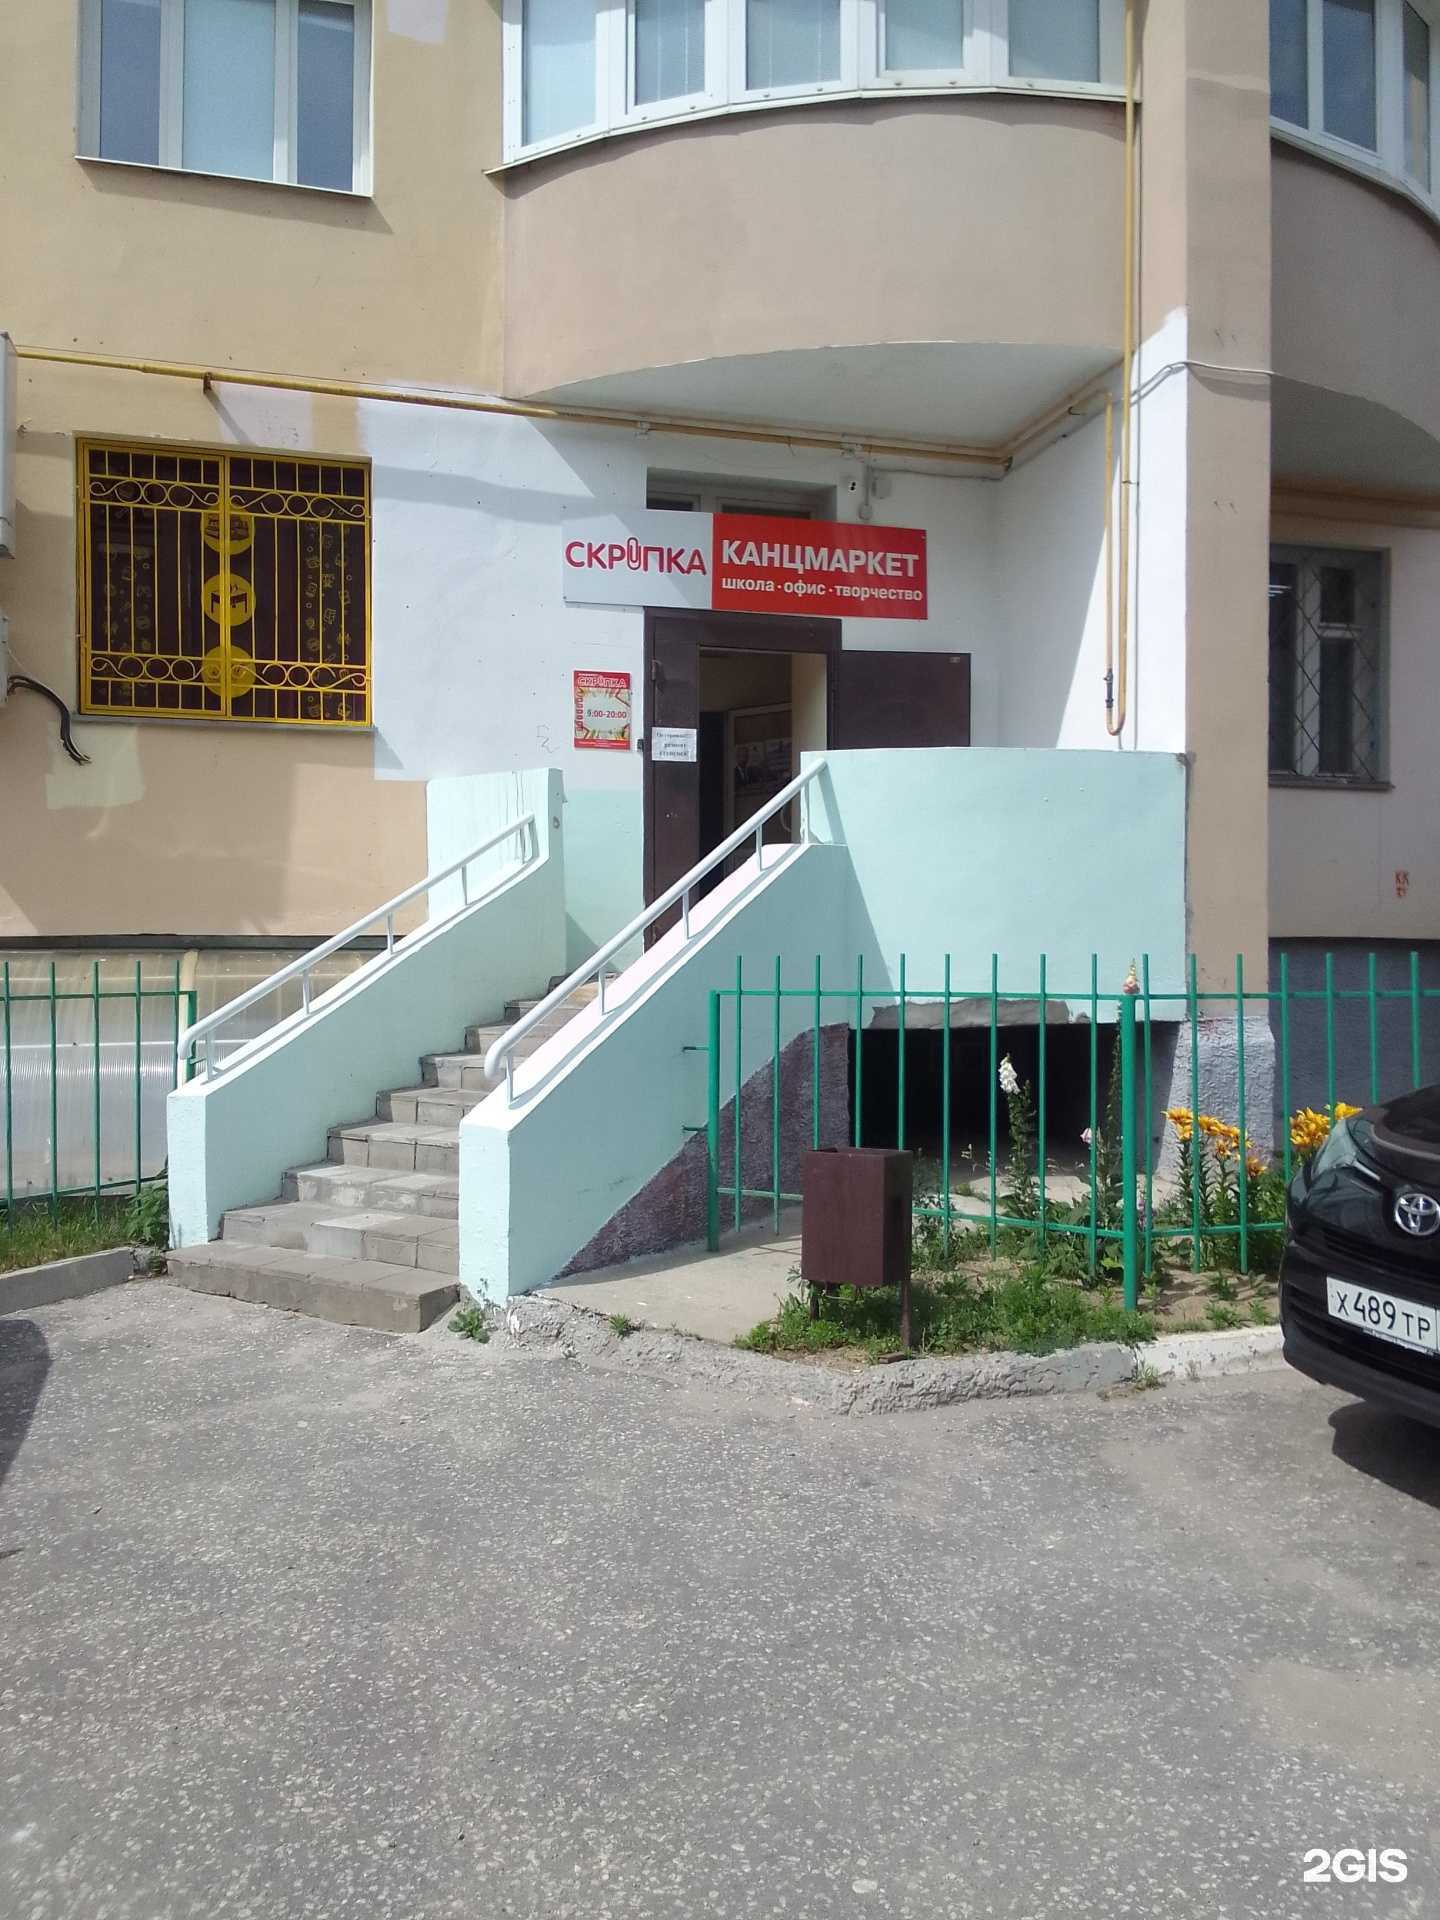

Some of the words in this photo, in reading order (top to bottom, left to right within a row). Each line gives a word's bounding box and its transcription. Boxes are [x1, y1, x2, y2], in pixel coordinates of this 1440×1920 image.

[722, 539, 919, 577] КАНЦМАРКЕТ
[722, 577, 775, 592] школа
[783, 579, 826, 597] офис
[834, 584, 923, 601] творчество
[586, 709, 627, 719] 9:00-20:00
